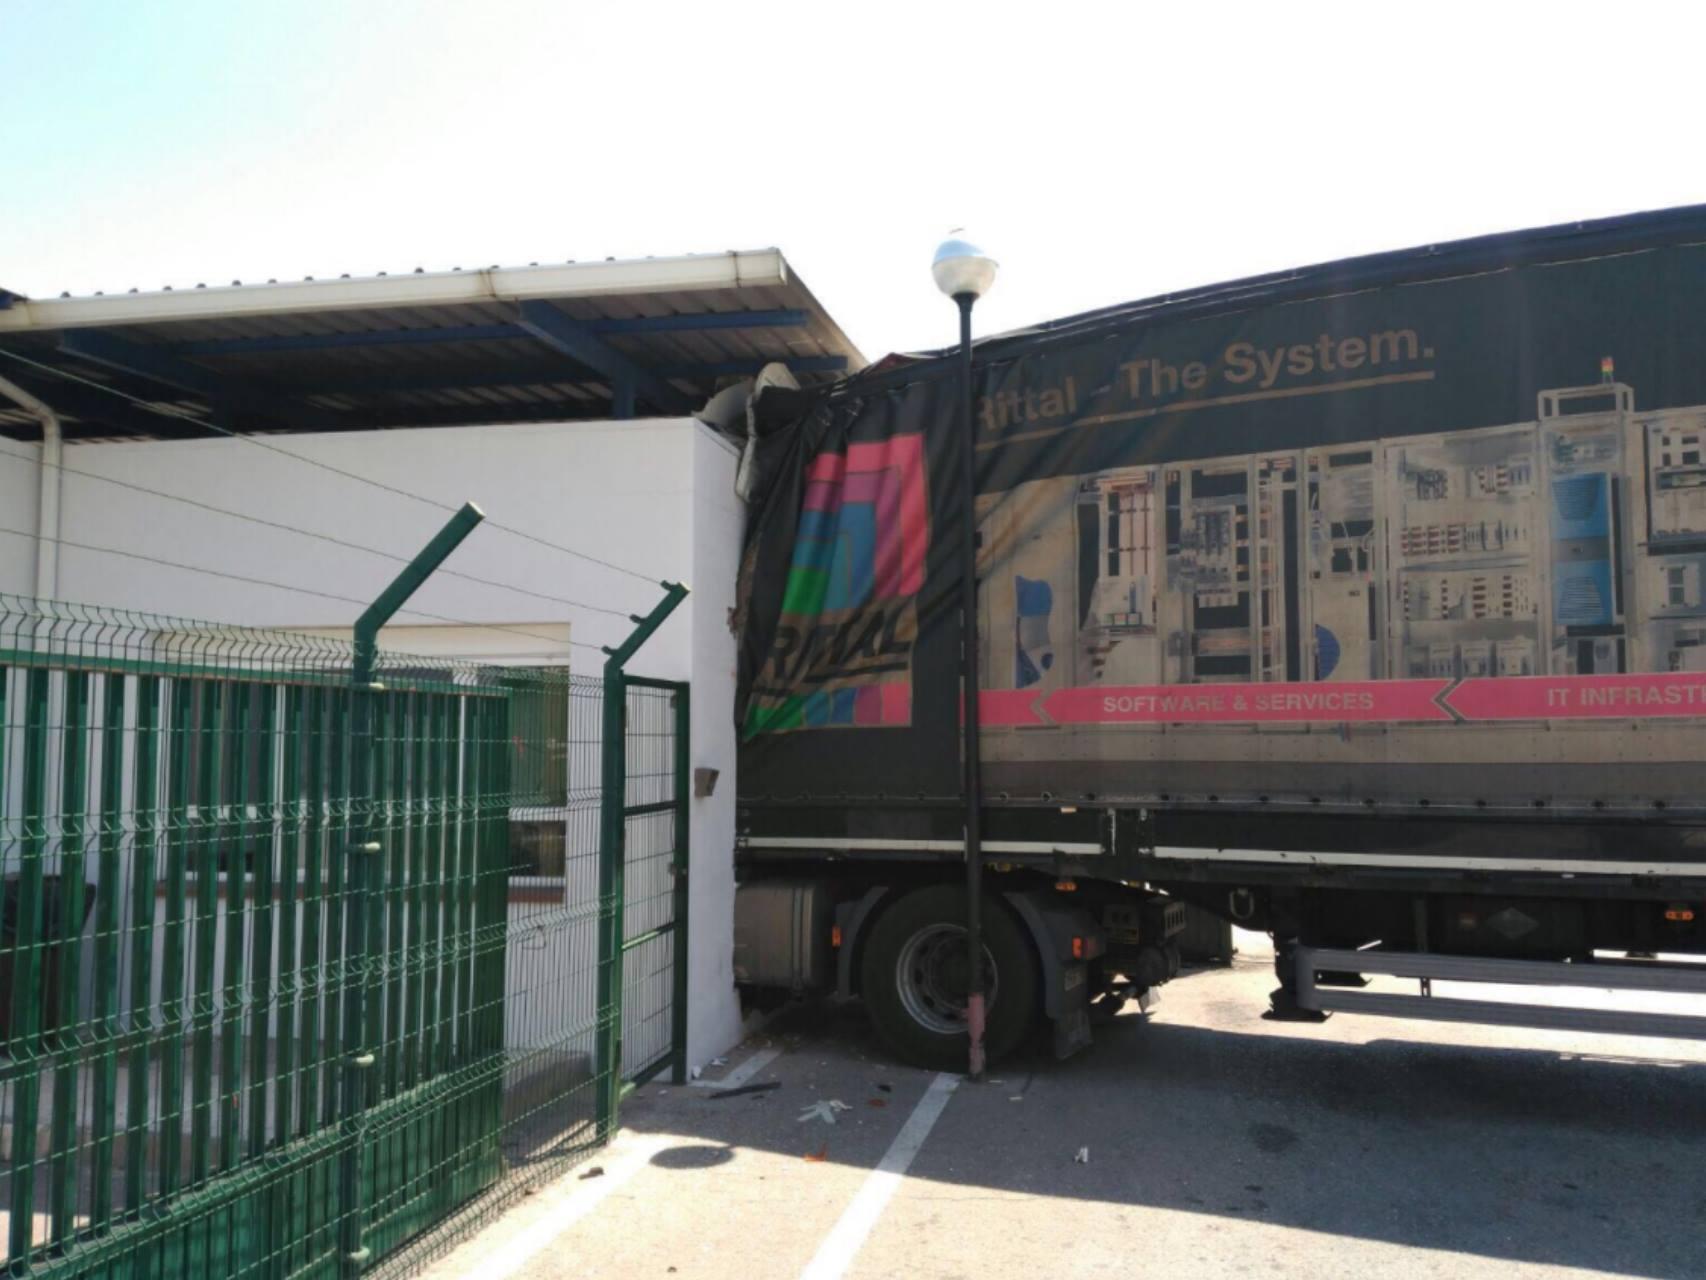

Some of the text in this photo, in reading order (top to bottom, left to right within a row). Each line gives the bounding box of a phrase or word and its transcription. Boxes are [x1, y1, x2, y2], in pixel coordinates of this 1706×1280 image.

[1119, 358, 1208, 398] The
[1224, 328, 1436, 389] System.
[1103, 692, 1374, 713] SOFTWARE & SERVICES
[1547, 688, 1570, 706] IT
